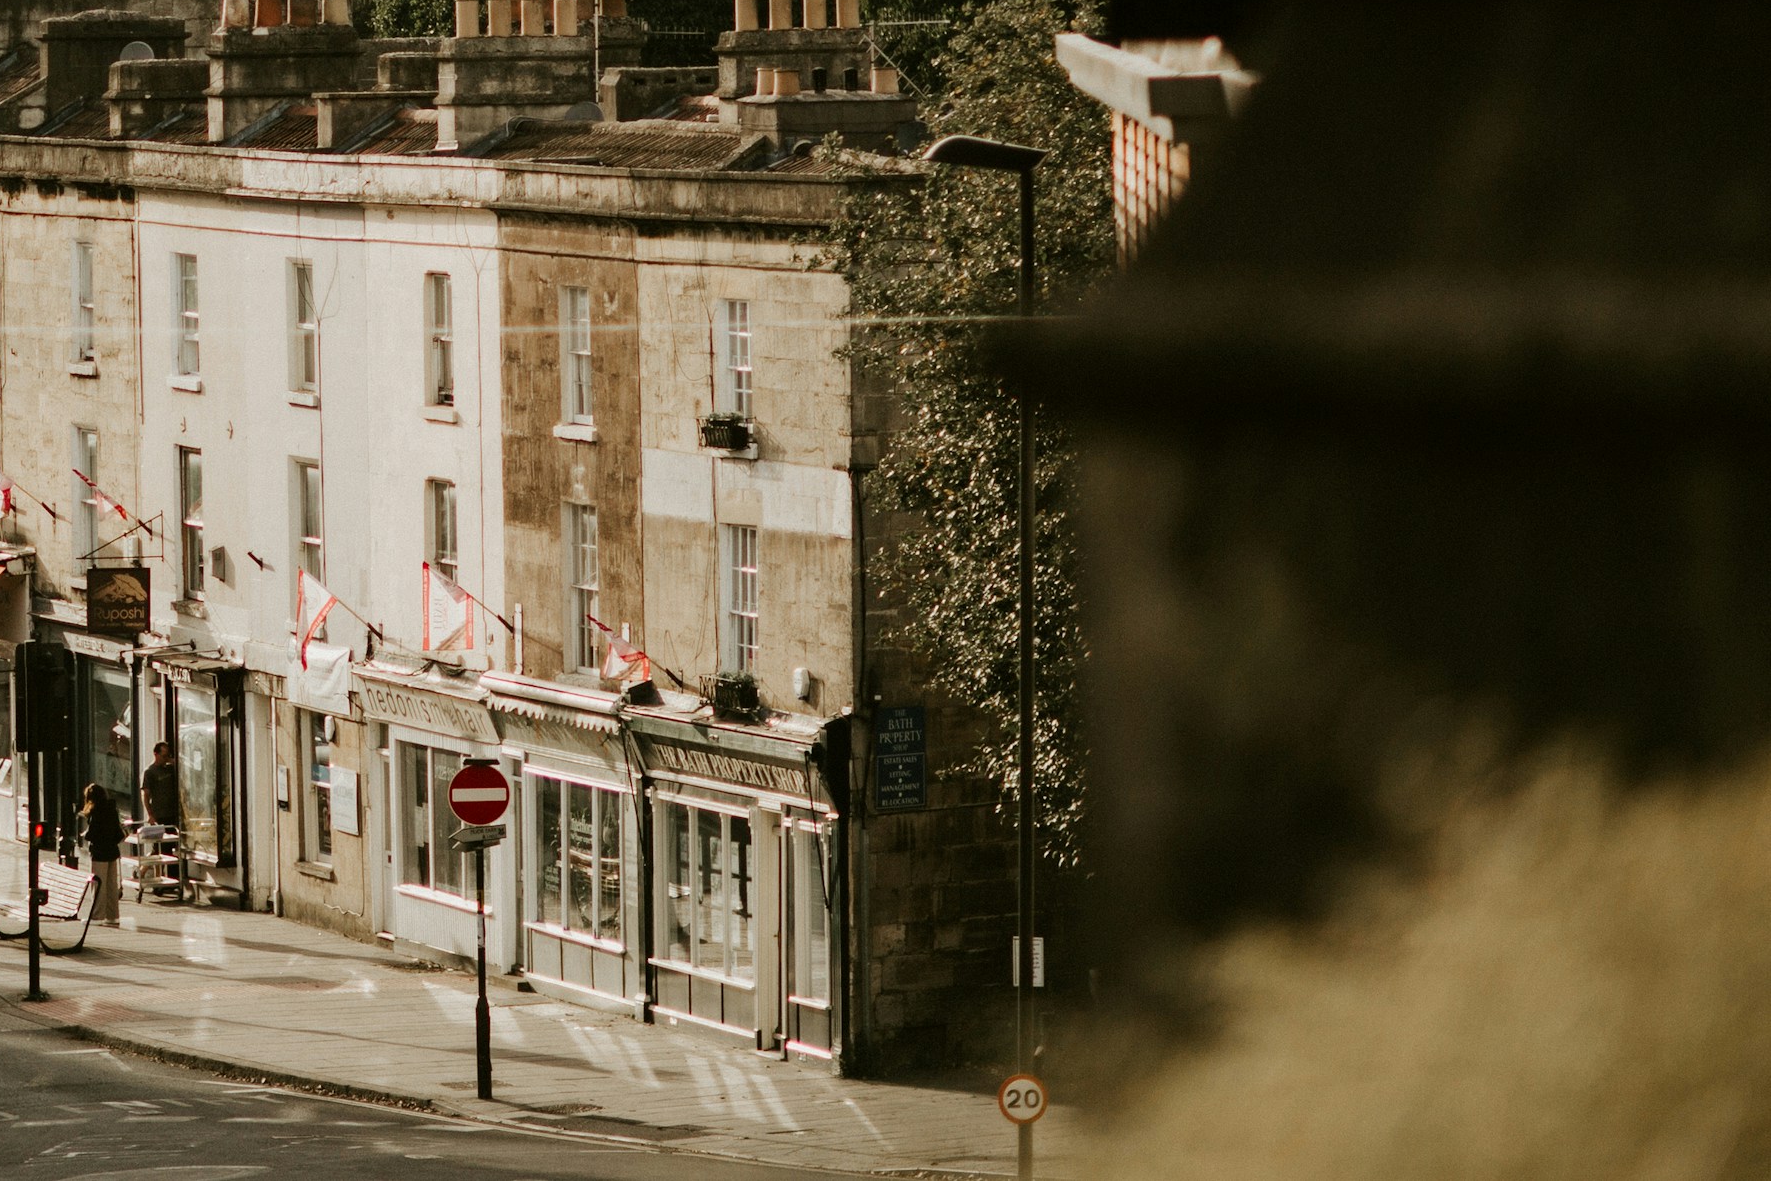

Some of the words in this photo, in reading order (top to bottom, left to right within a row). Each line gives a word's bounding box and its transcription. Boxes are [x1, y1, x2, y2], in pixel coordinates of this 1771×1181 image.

[94, 606, 145, 622] Ruposhi
[364, 678, 446, 727] hedonism
[451, 695, 489, 735] hair
[888, 717, 913, 730] BATH
[879, 730, 923, 744] PROPERTY
[652, 743, 681, 769] THE
[677, 747, 710, 775] BATH
[708, 753, 775, 789] PROPERTY
[772, 766, 806, 794] SHOP
[881, 783, 920, 792] MANAGEMENT
[1007, 1089, 1040, 1109] 20
